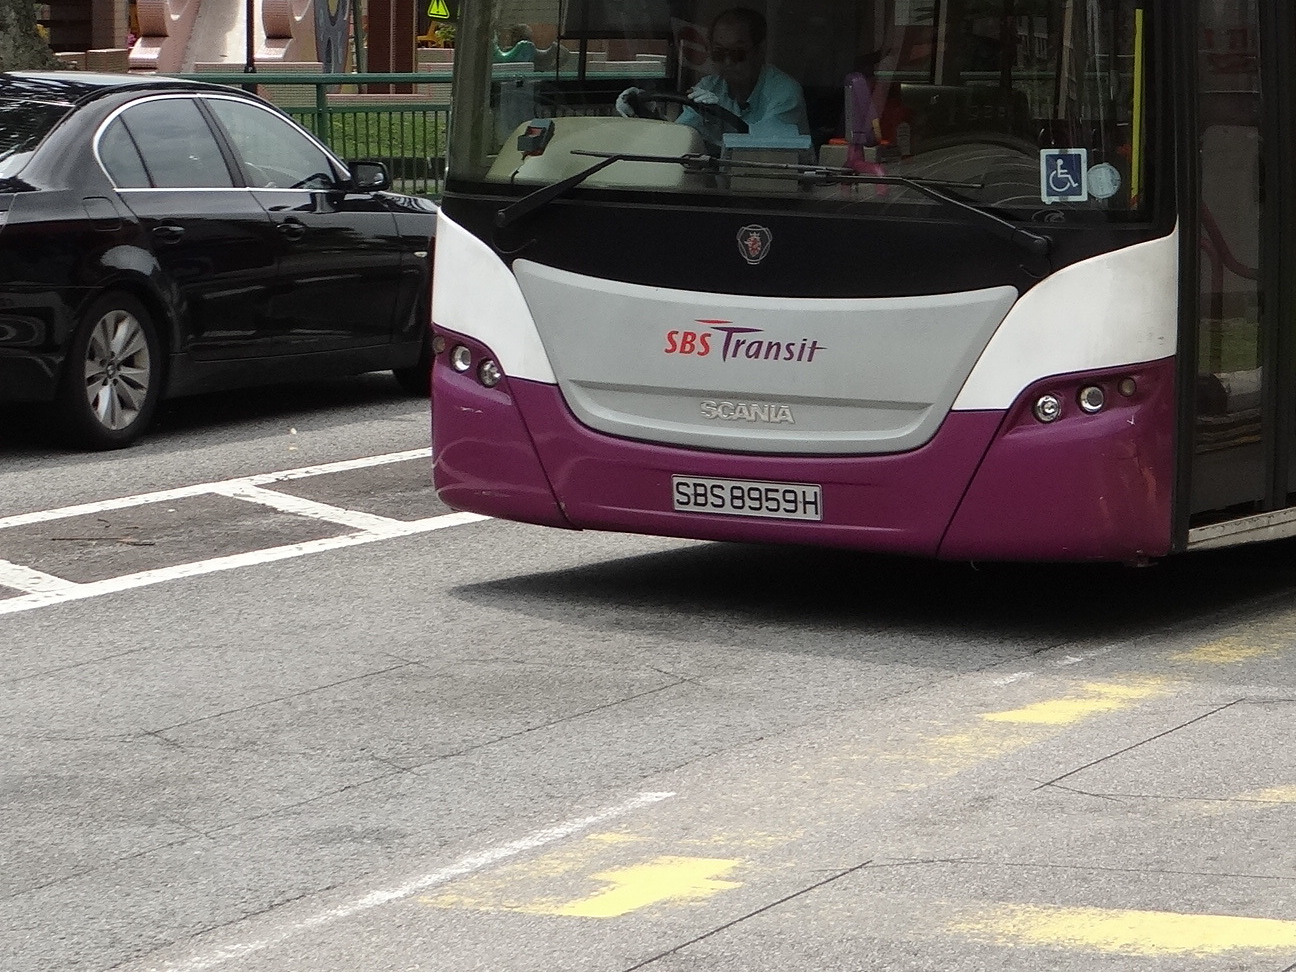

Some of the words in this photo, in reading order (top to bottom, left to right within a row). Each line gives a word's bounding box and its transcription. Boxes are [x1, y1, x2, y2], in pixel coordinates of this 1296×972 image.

[664, 330, 712, 357] SBS
[710, 326, 828, 363] Transit
[700, 400, 796, 424] SCANIA
[675, 481, 819, 516] SBS8959H
